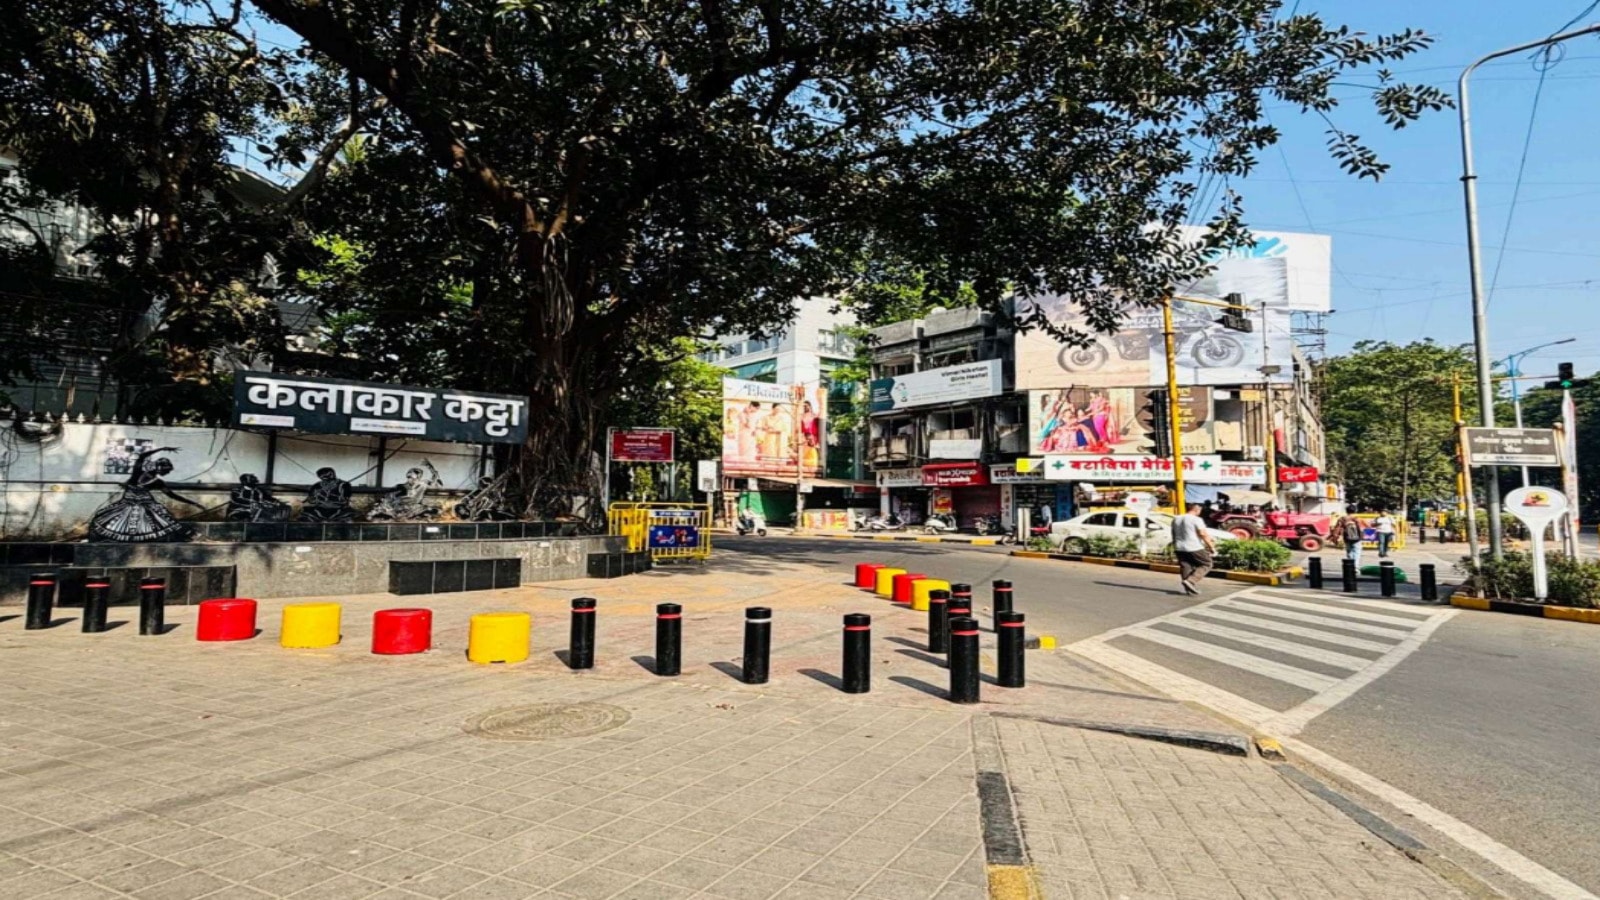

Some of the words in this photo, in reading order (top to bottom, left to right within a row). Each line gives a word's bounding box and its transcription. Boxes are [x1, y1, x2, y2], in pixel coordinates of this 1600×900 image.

[244, 376, 437, 420] कलाकार
[442, 393, 525, 437] कट्टा
[1069, 457, 1136, 470] बटाविया
